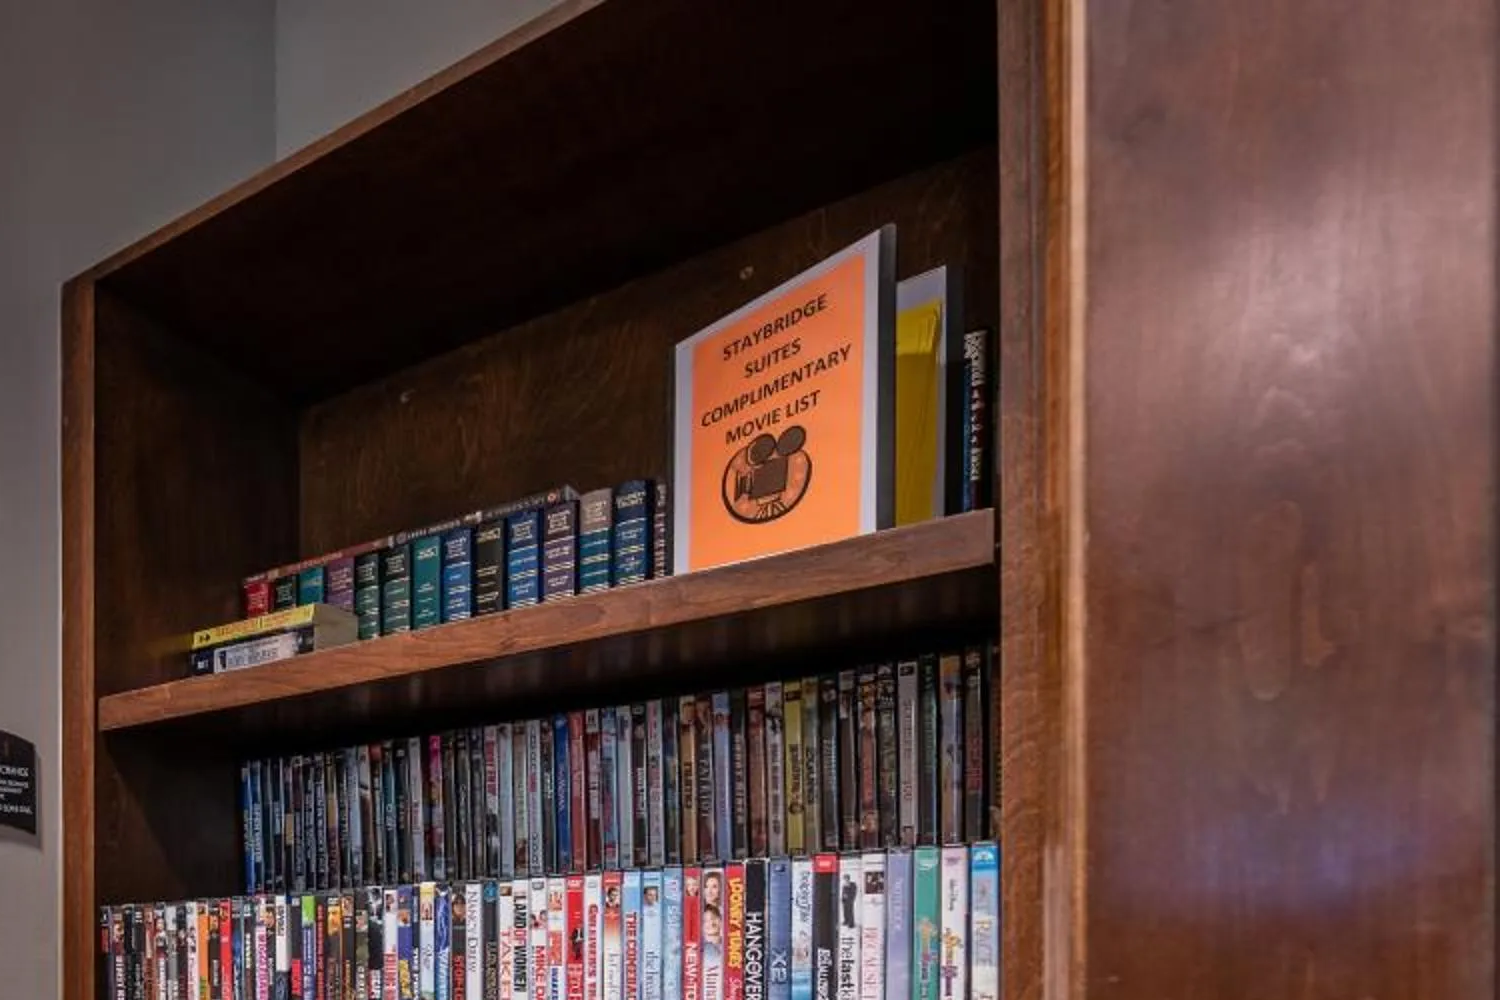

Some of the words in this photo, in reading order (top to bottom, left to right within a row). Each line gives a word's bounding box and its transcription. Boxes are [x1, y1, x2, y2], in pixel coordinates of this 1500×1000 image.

[723, 294, 828, 361] STAYBRIDGE
[744, 338, 802, 379] SUITES
[700, 344, 852, 428] COMPLIMENTARY
[725, 407, 782, 445] MOVIE
[785, 390, 821, 419] LIST
[467, 891, 479, 932] NANCY
[729, 877, 742, 928] LOONEY
[626, 912, 637, 936] THE
[467, 937, 479, 972] DREW
[535, 945, 546, 981] MIKE
[684, 942, 697, 976] NEW
[729, 930, 742, 968] TUNES
[746, 912, 761, 1000] HANGOVER
